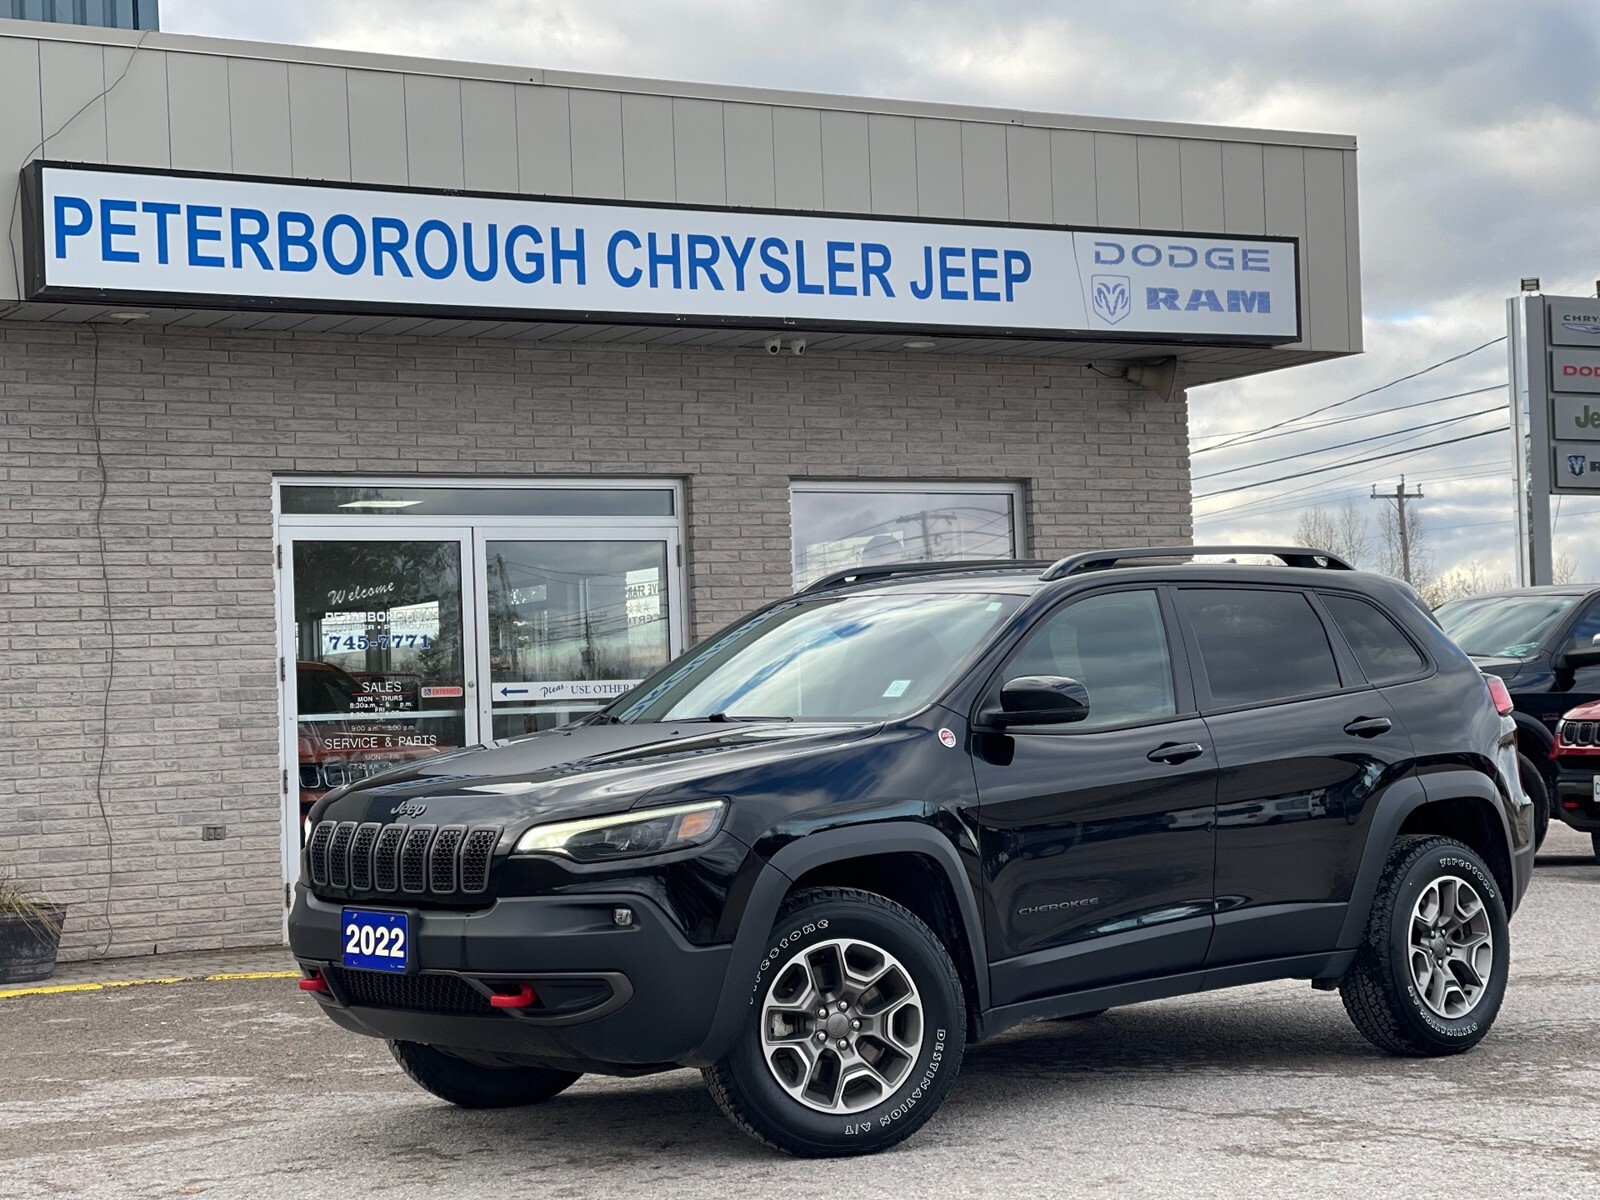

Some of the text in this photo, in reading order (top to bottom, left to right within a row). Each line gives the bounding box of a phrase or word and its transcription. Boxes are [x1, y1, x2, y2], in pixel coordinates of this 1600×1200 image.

[53, 195, 1032, 303] PETERBOROUGH CHRYSLER JEEP
[1094, 241, 1270, 272] DODGE
[1146, 286, 1271, 314] RAM
[327, 582, 395, 606] Welcome
[329, 634, 431, 650] 745-7771
[361, 681, 402, 693] SALES
[593, 684, 630, 694] OTHER
[324, 734, 437, 750] SERVICE & PARTS
[390, 800, 428, 819] Jeep
[1018, 897, 1099, 915] CHEROKEE
[345, 923, 406, 958] 2022
[845, 1029, 946, 1135] DESTINATION A/T
